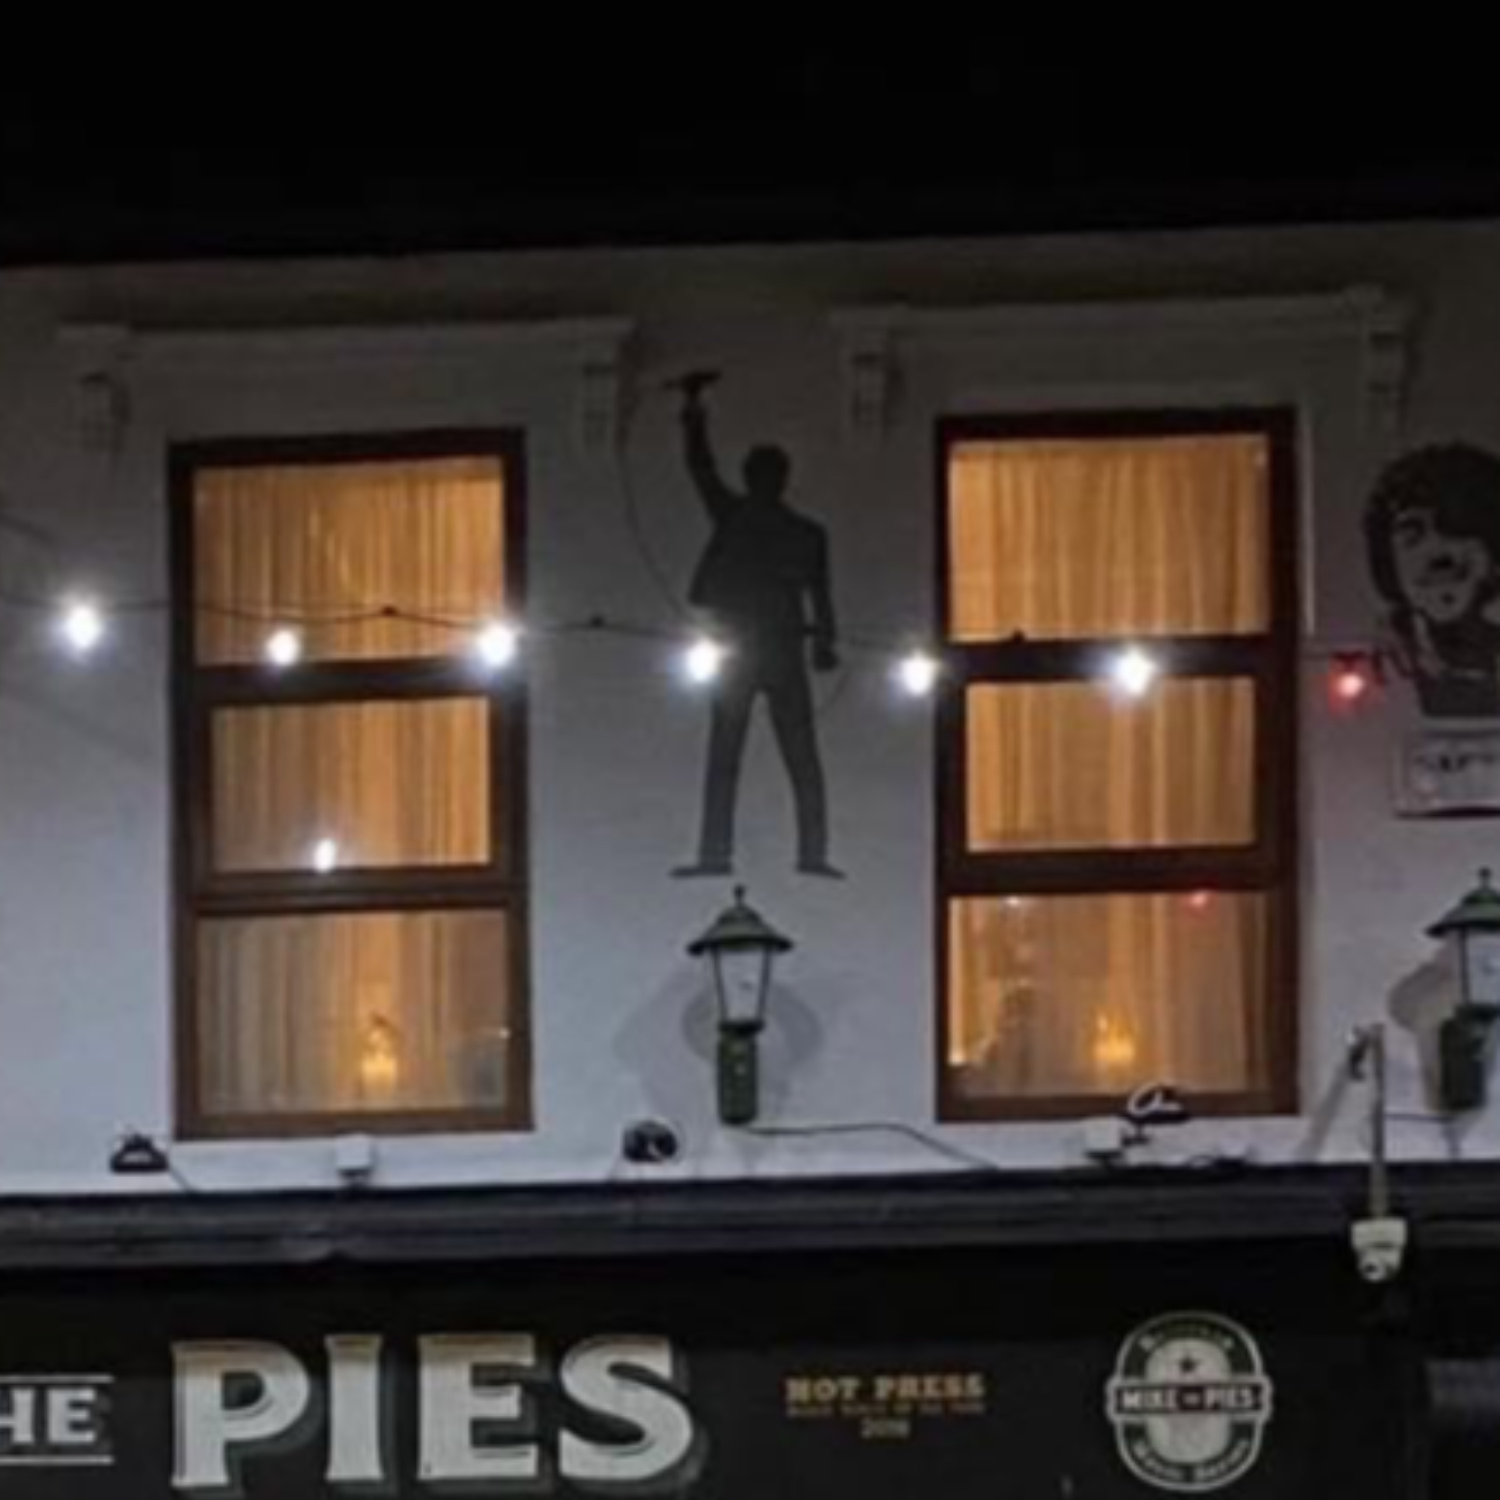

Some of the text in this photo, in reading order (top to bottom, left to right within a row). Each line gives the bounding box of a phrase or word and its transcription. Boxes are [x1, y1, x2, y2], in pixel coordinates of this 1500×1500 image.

[169, 1333, 696, 1490] PIES
[784, 1372, 987, 1403] HOT PRESS
